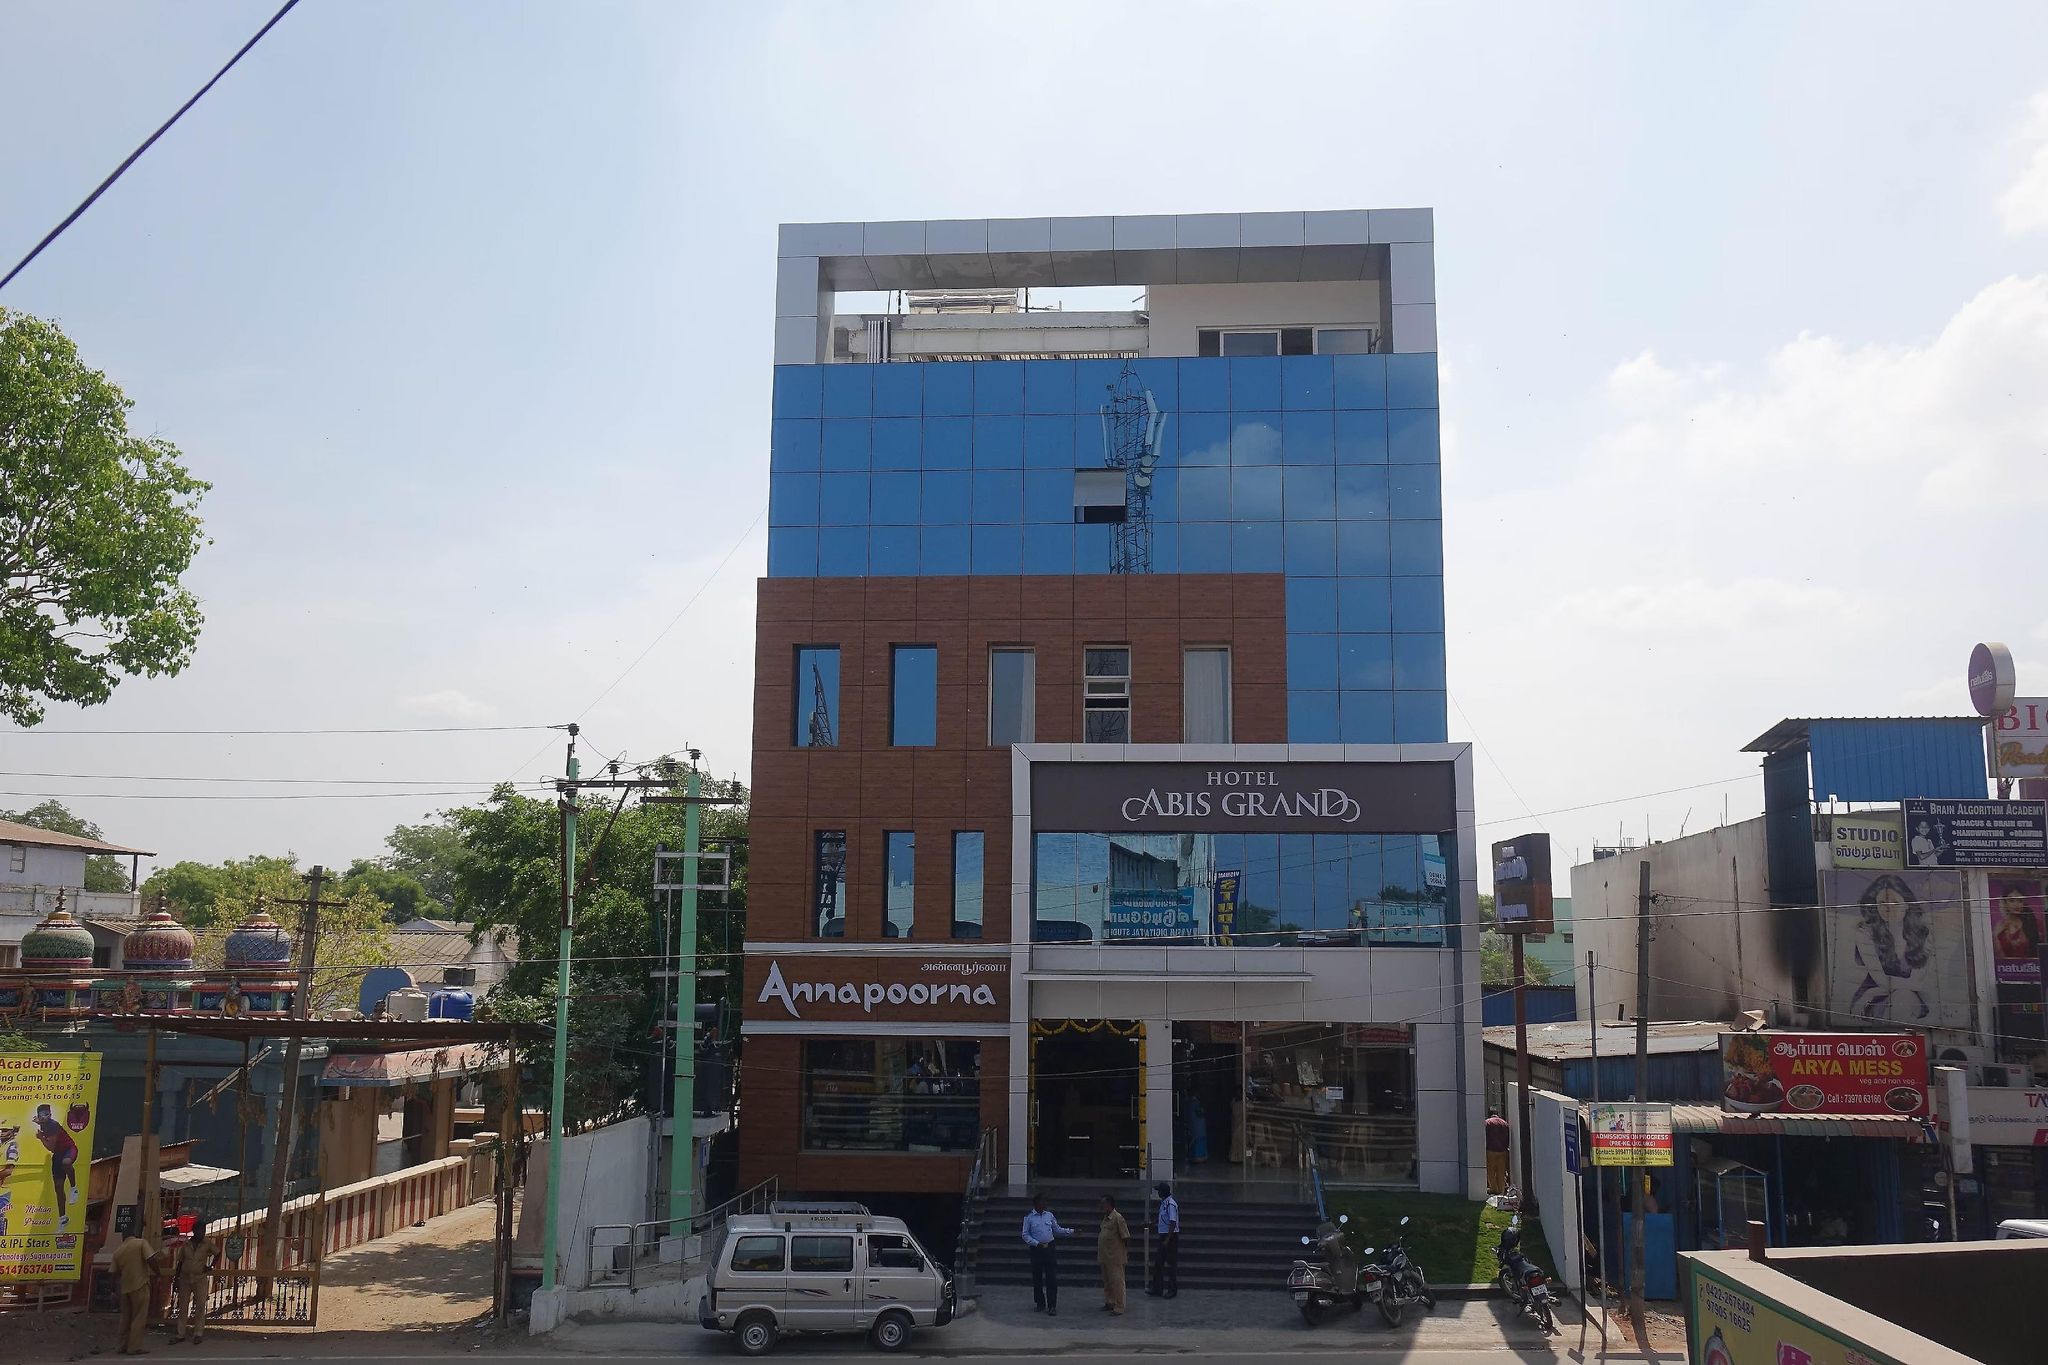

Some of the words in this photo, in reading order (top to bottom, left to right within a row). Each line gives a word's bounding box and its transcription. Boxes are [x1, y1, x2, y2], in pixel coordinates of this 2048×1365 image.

[1997, 704, 2048, 731] BI
[1206, 771, 1280, 786] HOTEL
[1121, 787, 1212, 821] ABIS
[1221, 787, 1361, 822] GRAND
[1930, 802, 1955, 815] BRAIN
[1957, 803, 2004, 816] ALGORITHM
[2006, 803, 2044, 816] ACADEMY
[1836, 827, 1899, 842] STUDIO
[1999, 841, 2044, 849] DEVELOPMENT
[757, 960, 996, 1019] Annapoorna
[1773, 1038, 1833, 1057] ஆர்யா
[1836, 1038, 1886, 1057] மெஸ்
[0, 1057, 61, 1071] Academy
[1791, 1059, 1843, 1075] ARYA
[1849, 1059, 1903, 1076] MESS
[16, 1073, 43, 1083] Camp
[48, 1072, 71, 1081] 2019
[80, 1072, 91, 1081] 20
[0, 1084, 36, 1093] Morning:
[1, 1240, 7, 1248] &
[9, 1239, 23, 1248] IPL
[26, 1238, 50, 1248] Stars
